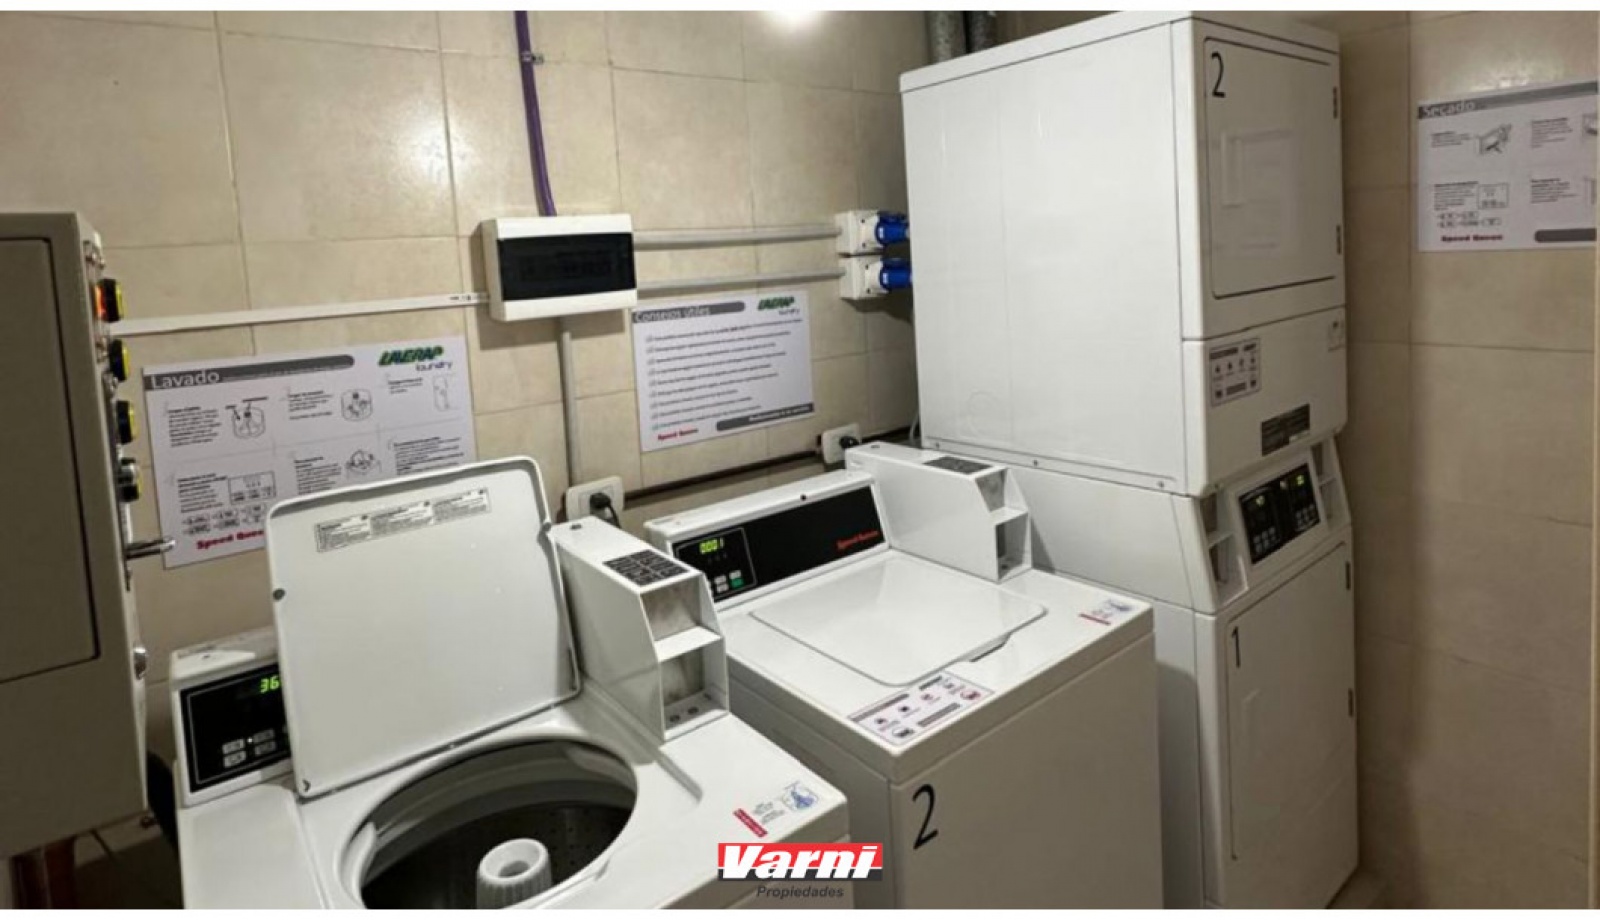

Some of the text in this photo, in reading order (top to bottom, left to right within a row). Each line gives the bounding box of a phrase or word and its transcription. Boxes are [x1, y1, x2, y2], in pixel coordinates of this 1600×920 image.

[1211, 51, 1226, 98] 2
[1423, 101, 1475, 117] Secado
[378, 345, 445, 367] LAVERAP
[152, 370, 220, 389] Lavado
[197, 534, 234, 549] Speed
[1231, 626, 1241, 668] 1
[912, 784, 939, 850] 2
